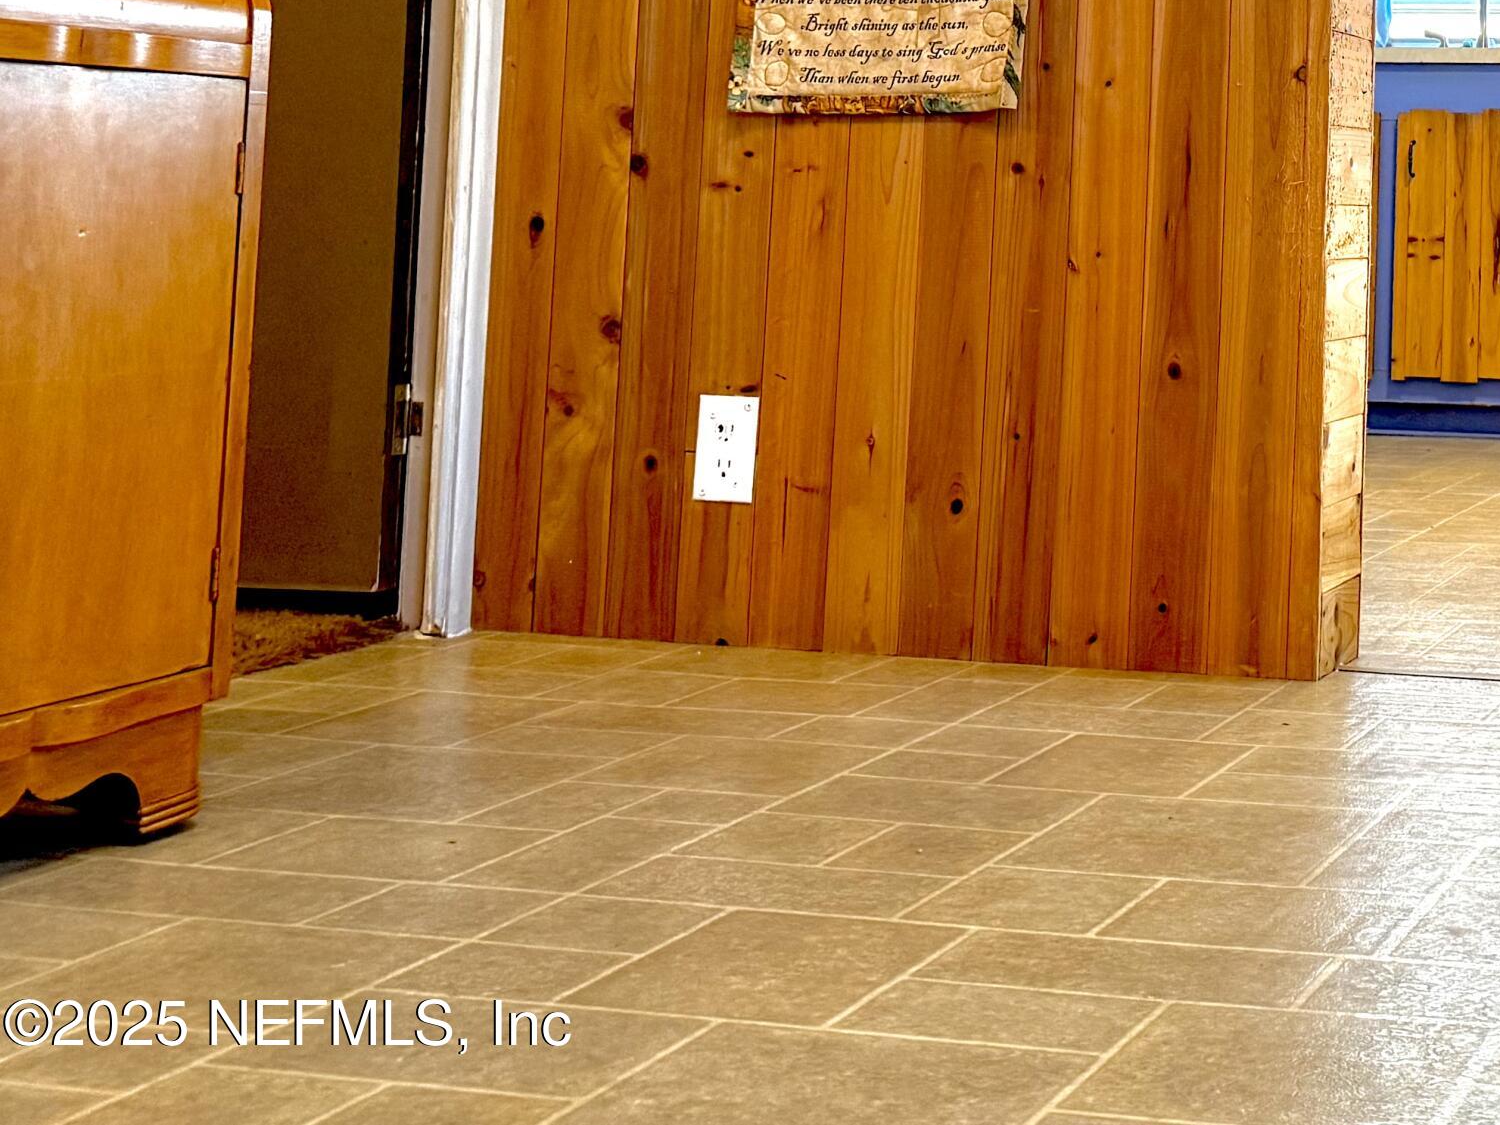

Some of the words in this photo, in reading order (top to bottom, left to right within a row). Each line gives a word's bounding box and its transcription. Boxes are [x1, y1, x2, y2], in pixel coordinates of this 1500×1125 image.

[801, 12, 849, 37] Bright
[851, 17, 899, 37] shining
[901, 19, 916, 31] as
[919, 16, 939, 31] the
[940, 20, 969, 31] sun,
[804, 46, 820, 57] no
[822, 42, 846, 57] less
[848, 43, 879, 65] days
[881, 47, 894, 57] to
[896, 44, 924, 63] sing
[965, 40, 1007, 60] praise
